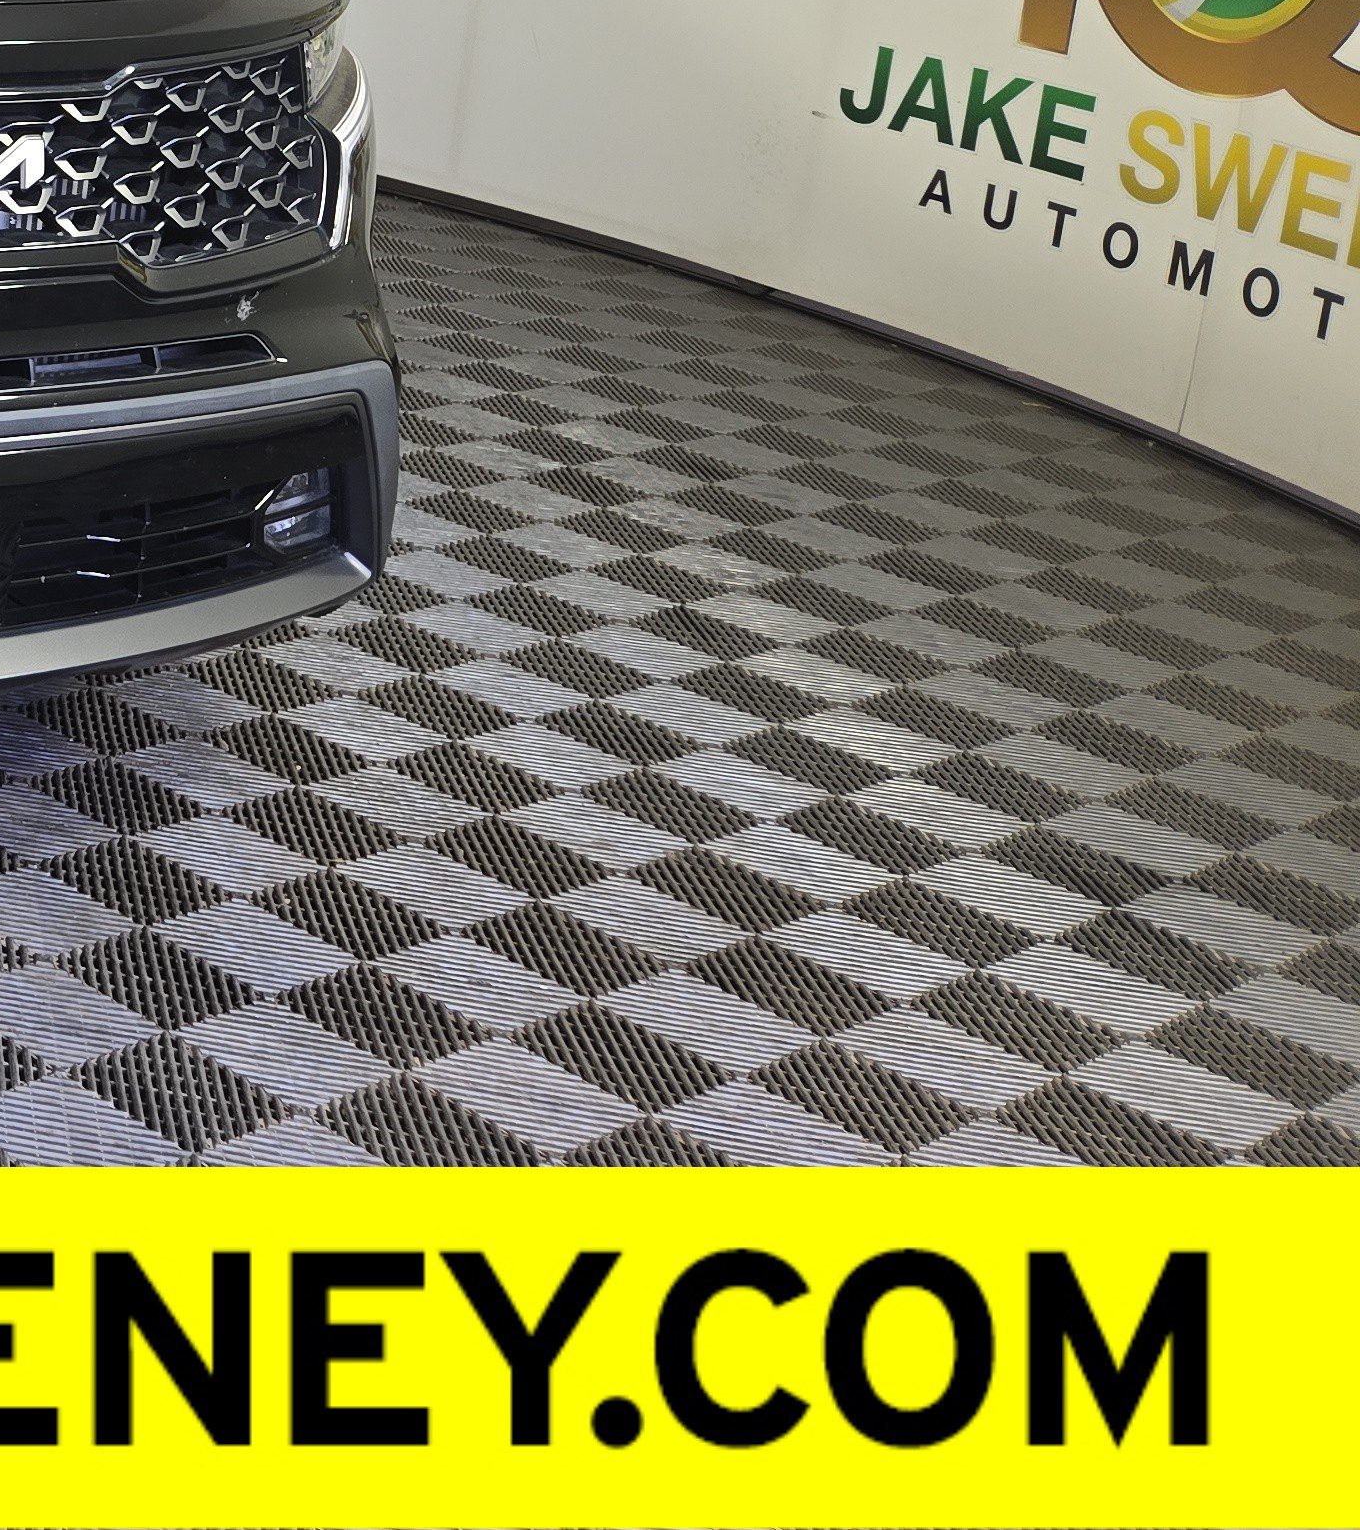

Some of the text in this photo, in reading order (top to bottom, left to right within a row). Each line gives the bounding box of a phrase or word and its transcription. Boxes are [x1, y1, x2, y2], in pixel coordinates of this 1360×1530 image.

[839, 45, 1360, 269] JAKE SWE
[919, 169, 1345, 340] AUTOMOT
